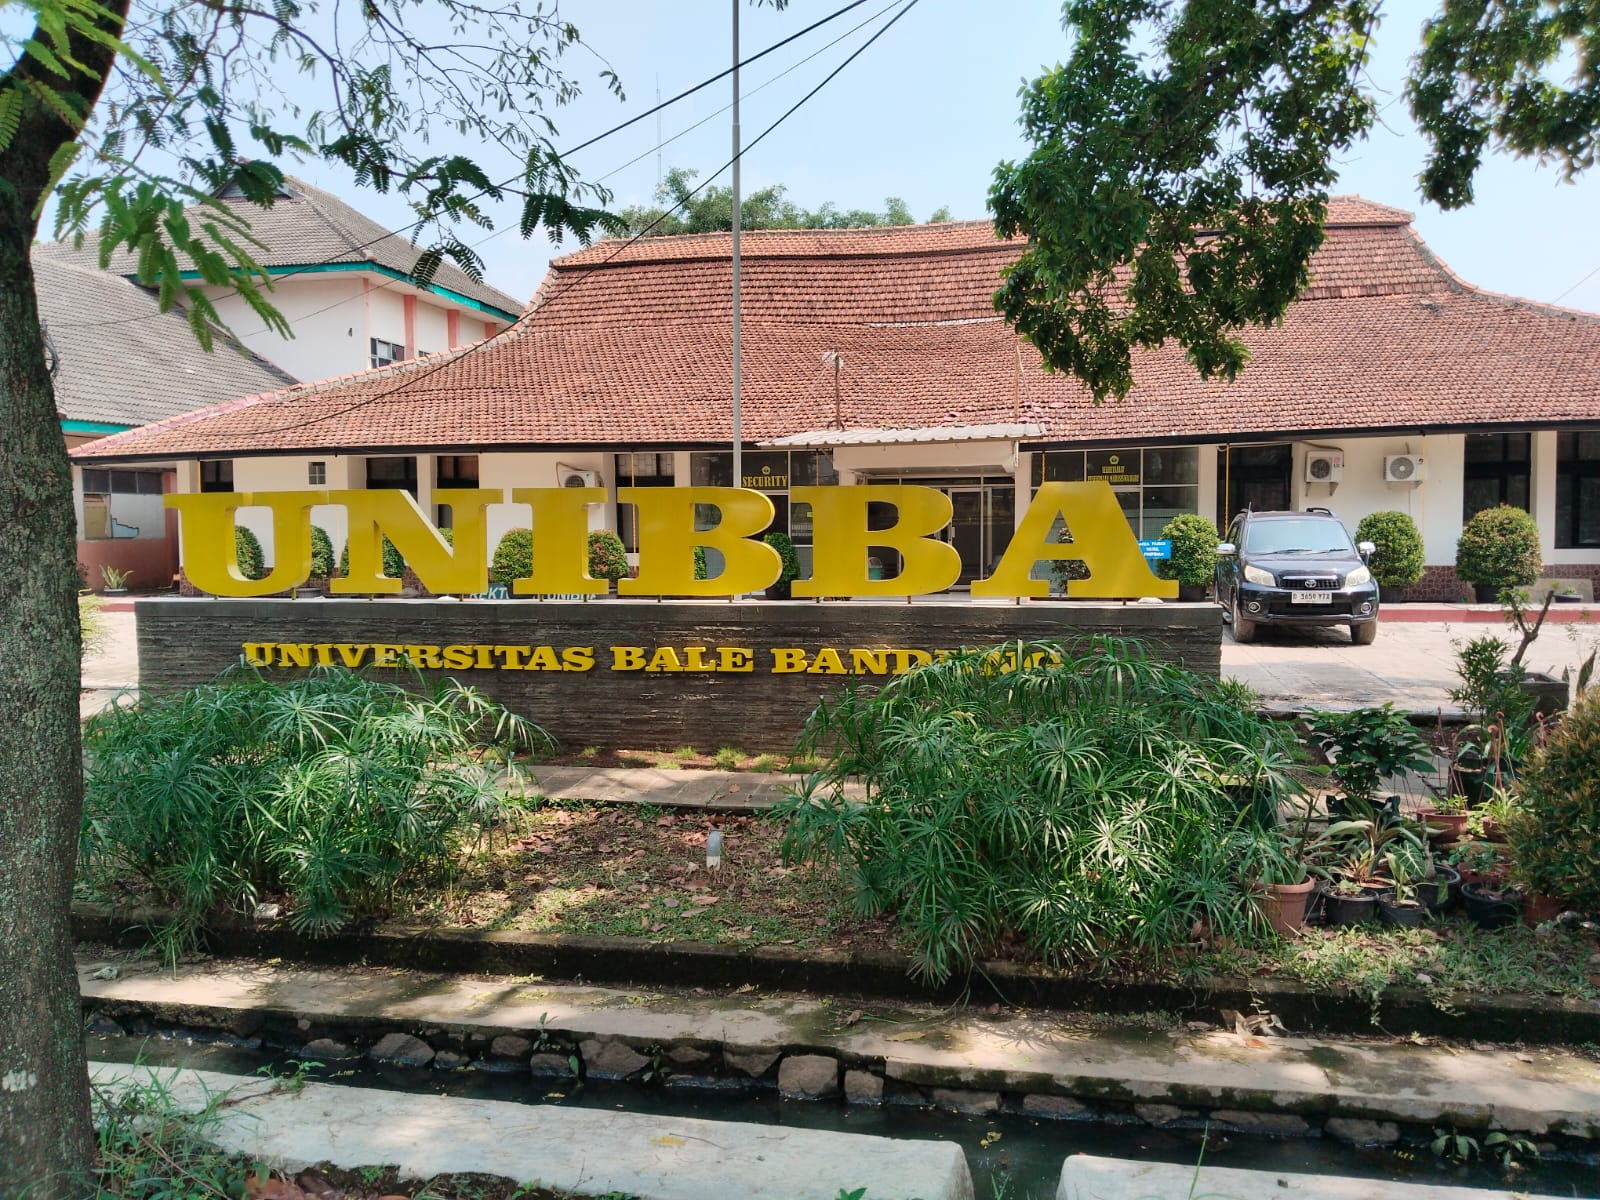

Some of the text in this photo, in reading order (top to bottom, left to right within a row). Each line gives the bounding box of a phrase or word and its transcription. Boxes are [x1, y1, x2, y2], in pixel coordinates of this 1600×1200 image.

[742, 475, 788, 488] SECURITY
[164, 479, 1181, 599] UNIBBA
[242, 642, 595, 672] UNIVERSITAS
[610, 646, 755, 673] BALE
